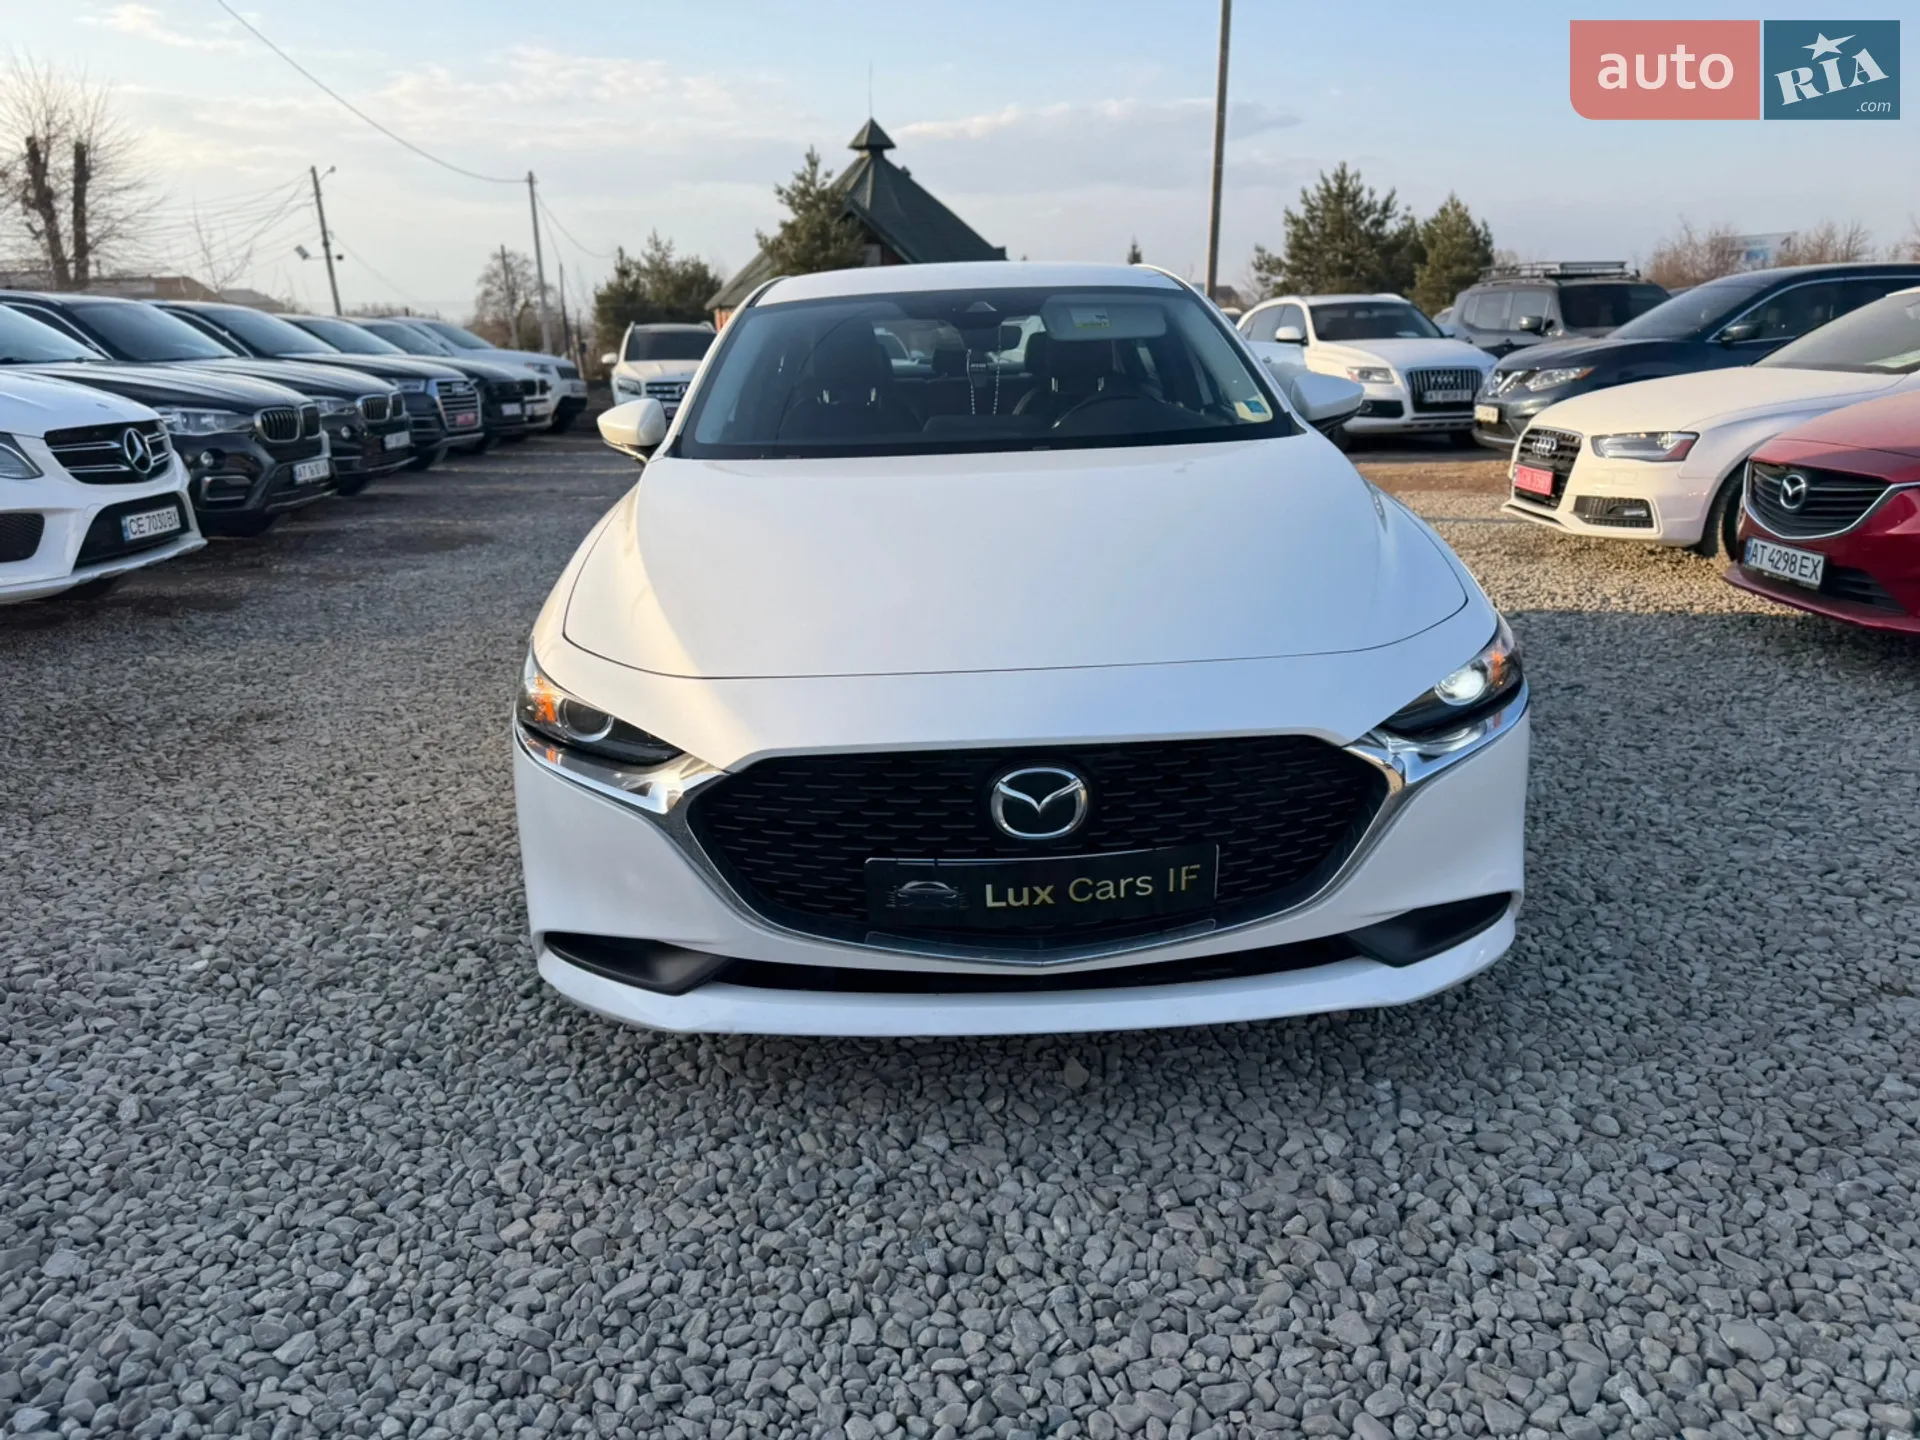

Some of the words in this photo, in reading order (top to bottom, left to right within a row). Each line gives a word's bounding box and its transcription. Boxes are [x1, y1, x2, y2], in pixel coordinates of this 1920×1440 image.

[985, 884, 1055, 907] Lux
[1068, 875, 1153, 902] Cars
[1168, 864, 1200, 892] IF
